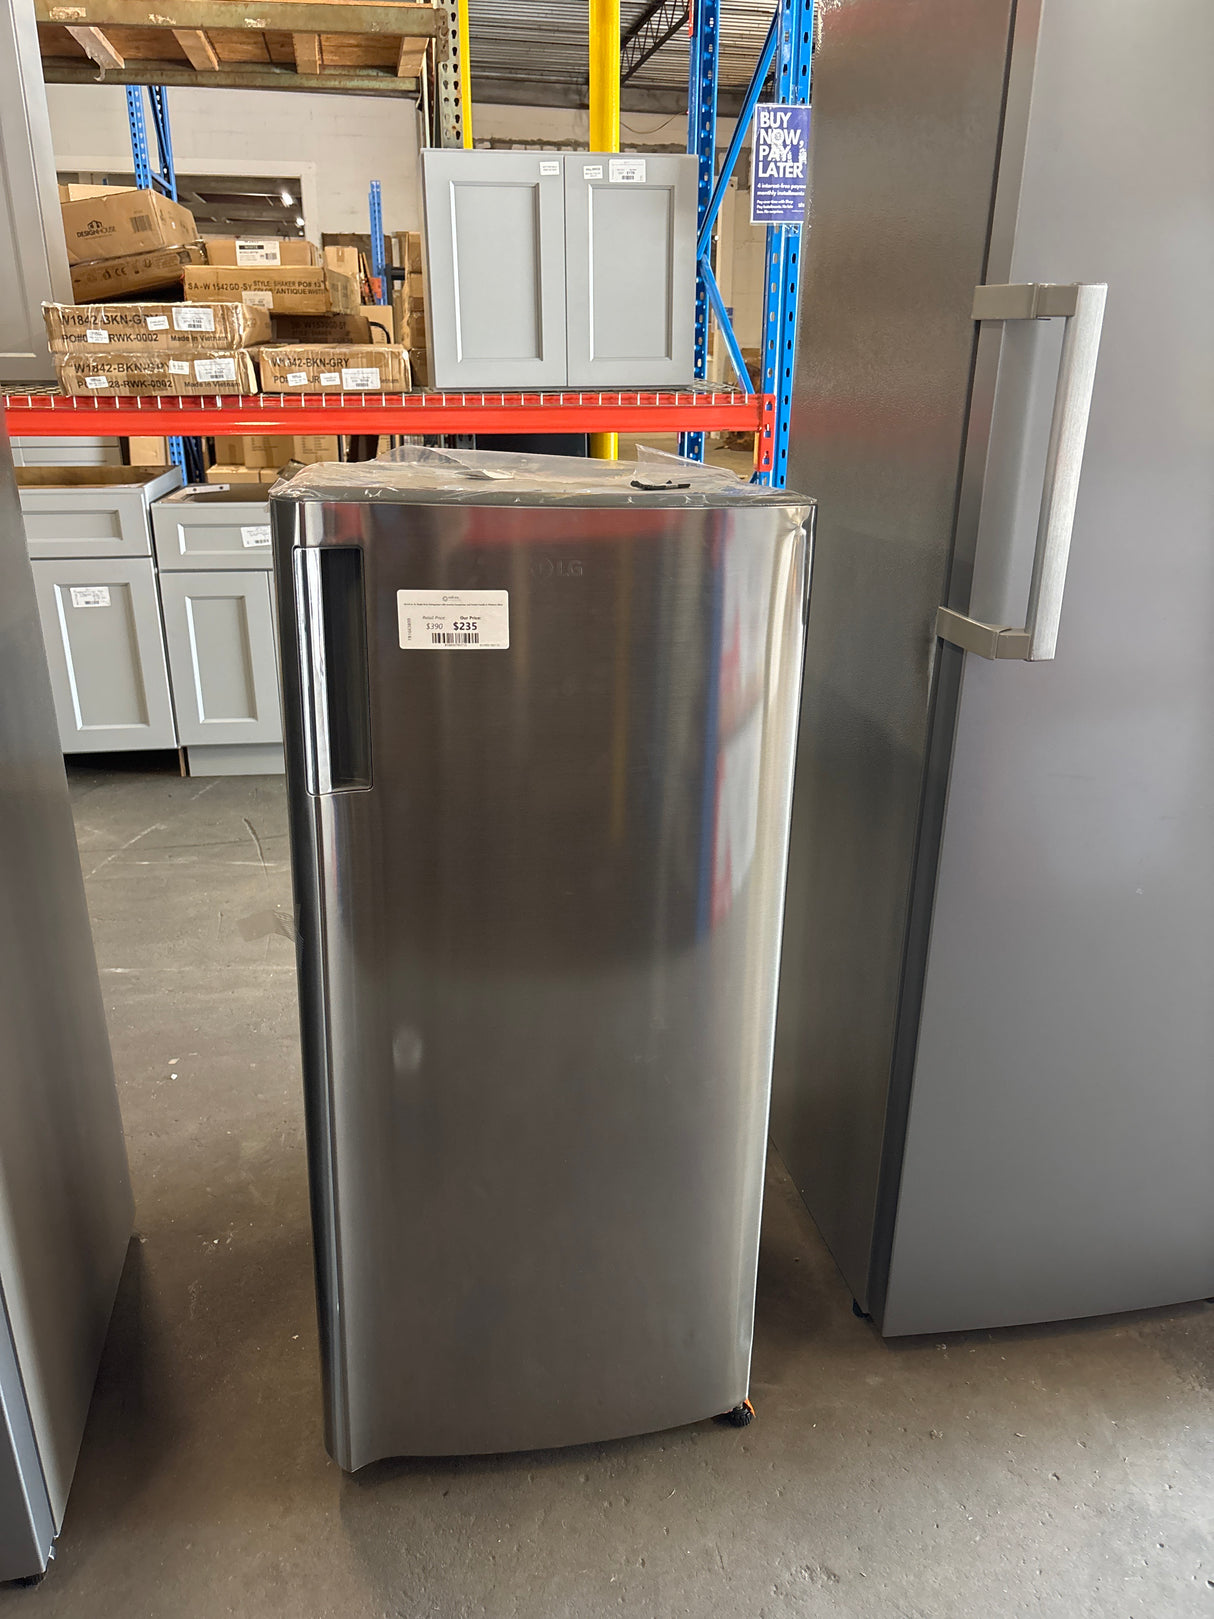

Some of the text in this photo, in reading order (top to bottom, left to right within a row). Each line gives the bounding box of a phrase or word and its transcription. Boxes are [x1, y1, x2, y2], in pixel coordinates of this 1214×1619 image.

[760, 112, 792, 128] BUY
[759, 129, 804, 148] NOW,
[758, 162, 804, 178] LATER
[426, 621, 478, 631] $390 $235
